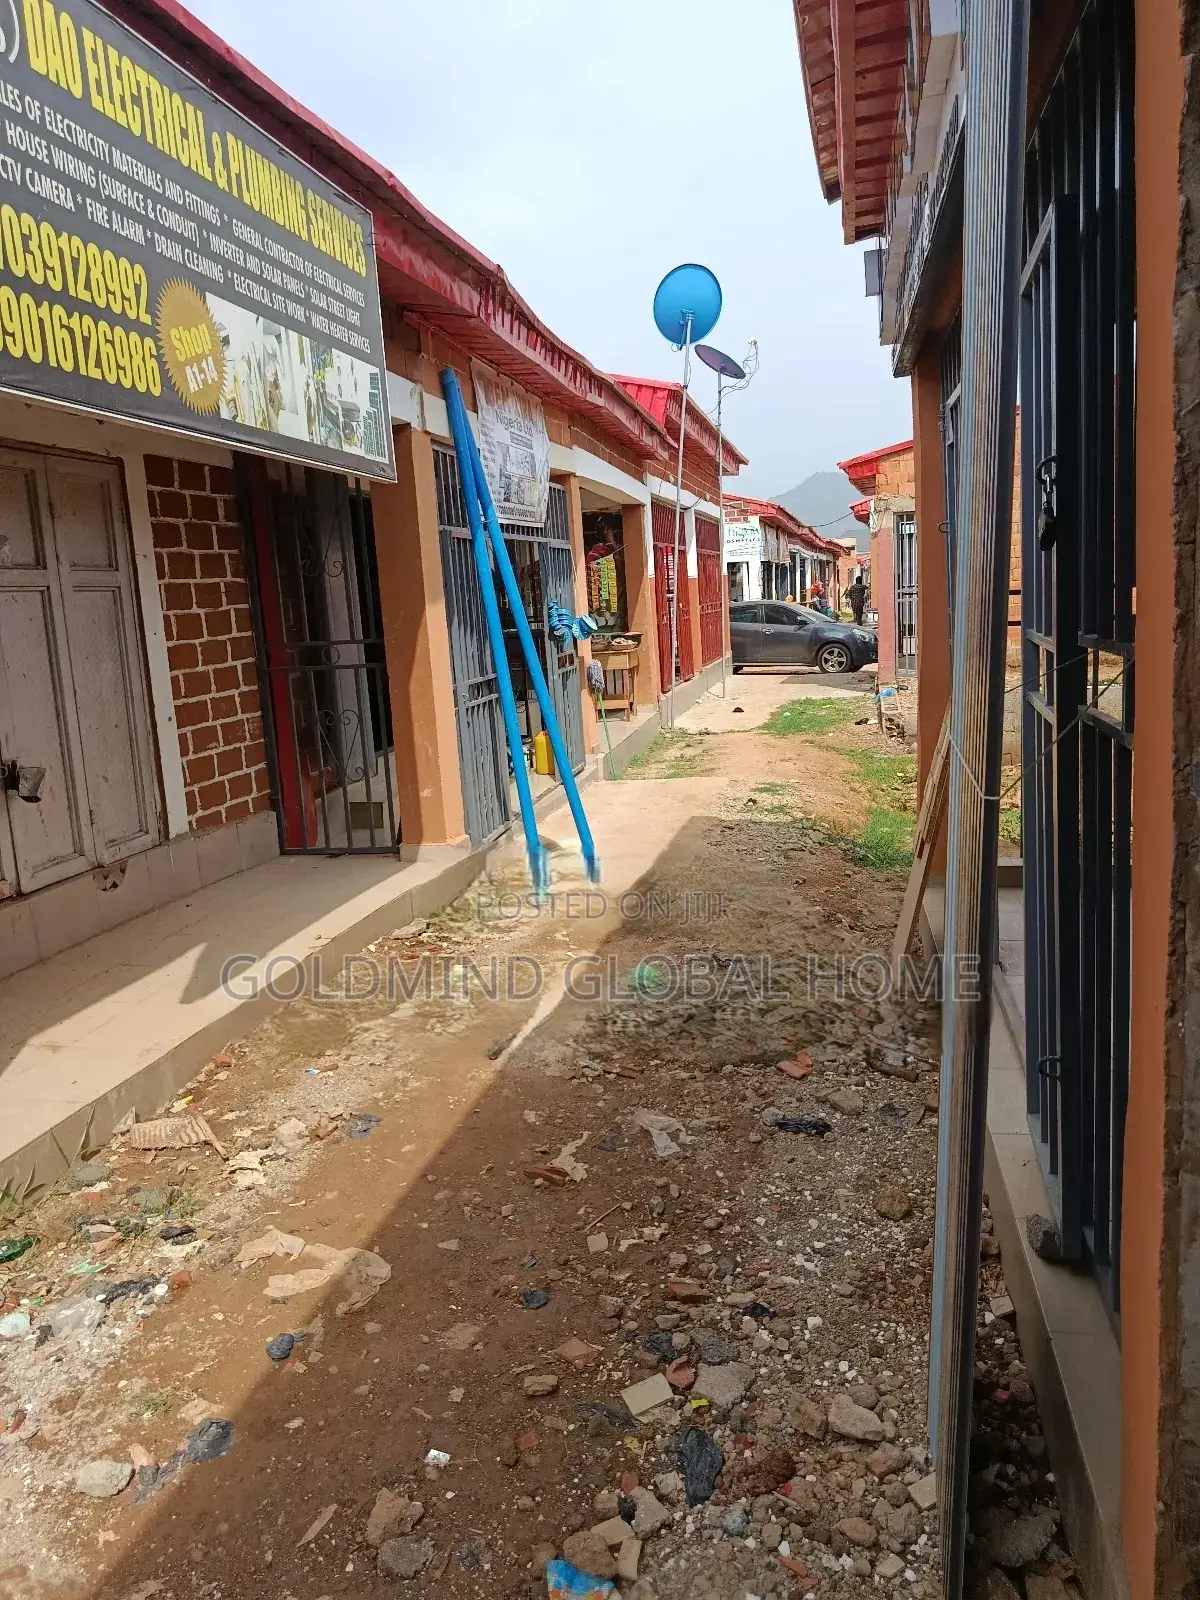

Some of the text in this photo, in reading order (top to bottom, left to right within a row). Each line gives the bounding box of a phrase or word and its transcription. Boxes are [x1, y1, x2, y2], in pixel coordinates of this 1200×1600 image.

[0, 79, 365, 308] LES OF ELECTRICITY MATERIALS AND FITTINGS GENERAL CONTRACTOR OF ELECTRICAL SERVICES
[23, 0, 83, 99] DAO
[82, 26, 213, 182] ELECTRICAL
[212, 131, 229, 192] &
[226, 131, 309, 242] PLUMBING
[306, 187, 367, 278] SERVICES
[0, 203, 152, 326] 039128992
[5, 118, 361, 328] HOUSE WIRING (SURFACE & CONDUIT) INVERTER AND SOLAR PANELS SOLAR STREET LIGHT
[25, 167, 76, 212] CAMERA
[85, 197, 110, 228] FIRE
[111, 210, 146, 246] ALARM
[154, 232, 184, 265] DRAIN
[184, 248, 224, 284] CLEANING
[233, 272, 273, 308] ELECTRICAL
[272, 292, 287, 313] SITE
[286, 298, 306, 323] WORK
[310, 311, 330, 335] WATER
[329, 320, 349, 344] HEATER
[348, 331, 371, 354] SERVICES
[0, 285, 162, 397] 9016126986
[169, 323, 213, 363] Shop
[184, 356, 219, 394] A1-14
[495, 409, 523, 431] Nigeria
